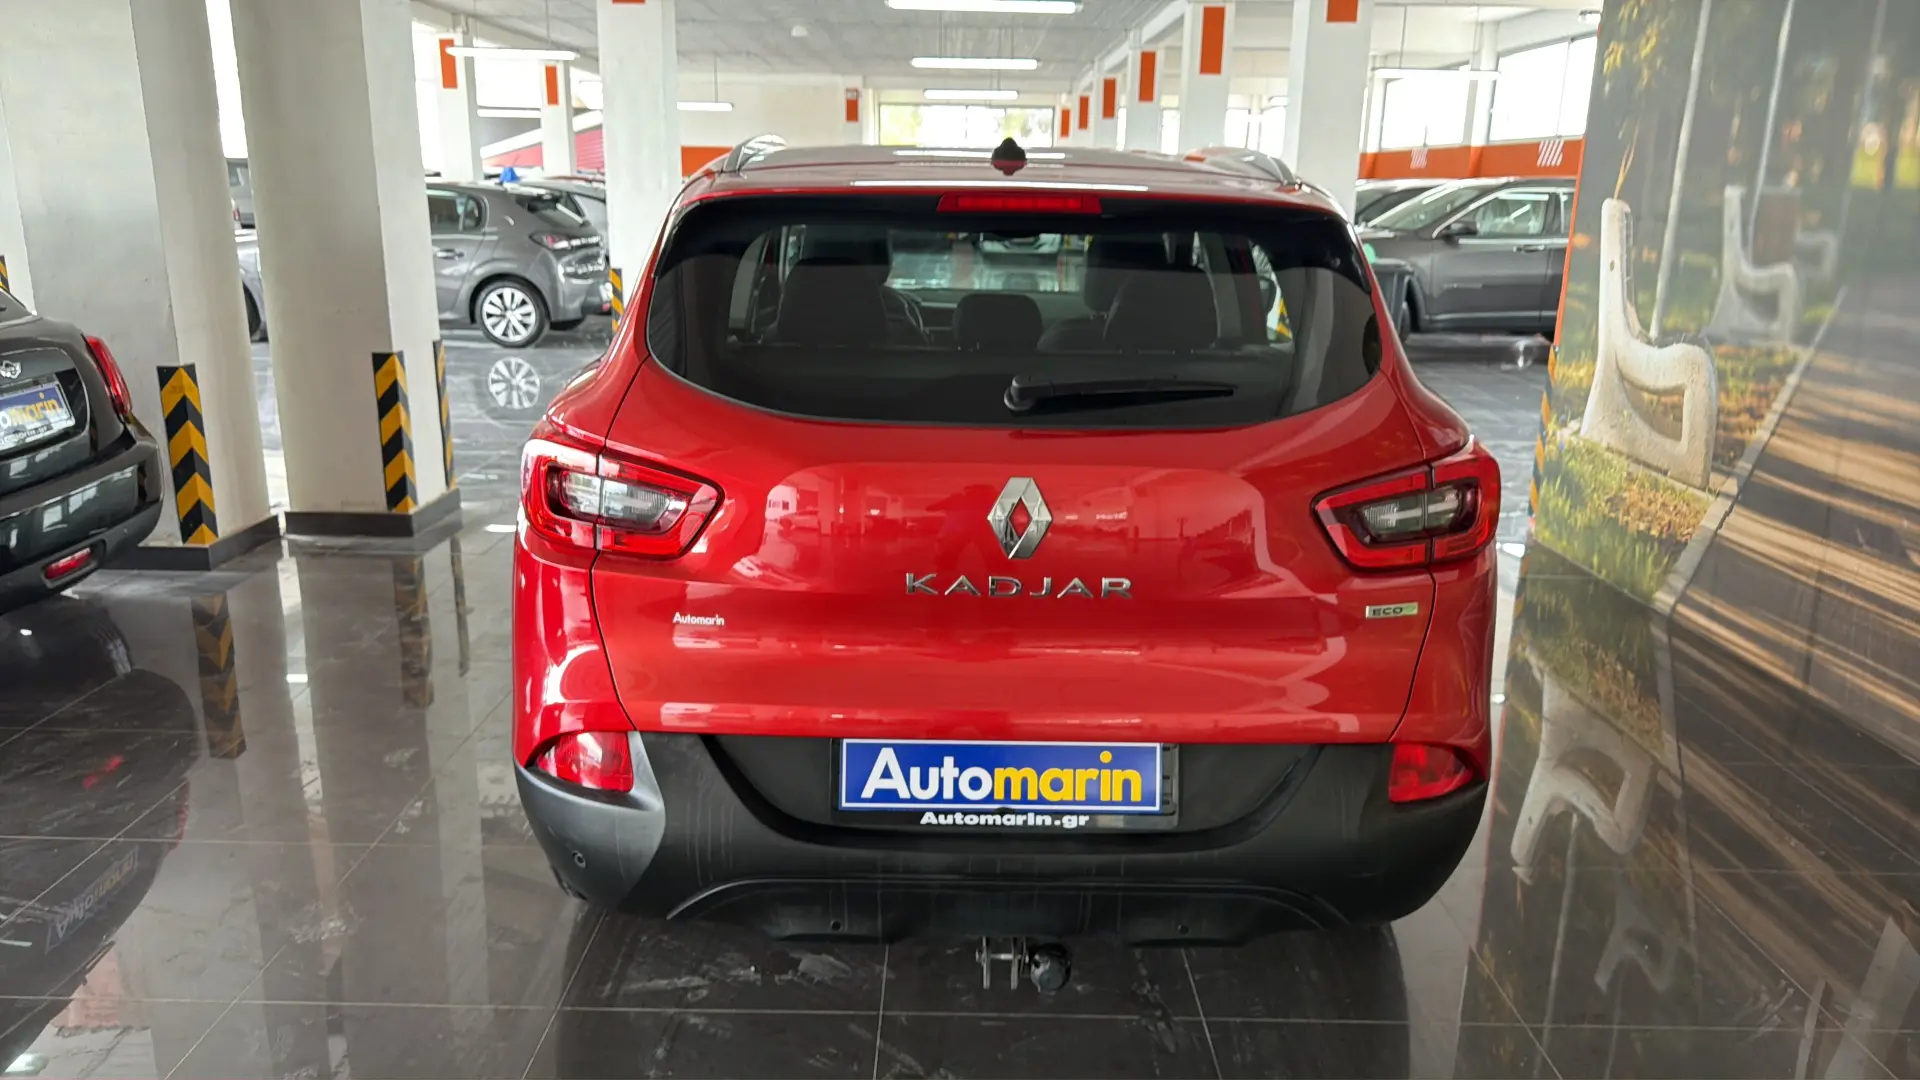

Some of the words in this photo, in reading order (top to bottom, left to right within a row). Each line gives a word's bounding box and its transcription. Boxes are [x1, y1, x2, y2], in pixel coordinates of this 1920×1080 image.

[905, 572, 1133, 598] KADJAR
[672, 611, 726, 626] Automarin
[1372, 607, 1404, 616] ECO
[860, 747, 1143, 802] Automarin
[919, 811, 1090, 829] Automarin.gr
